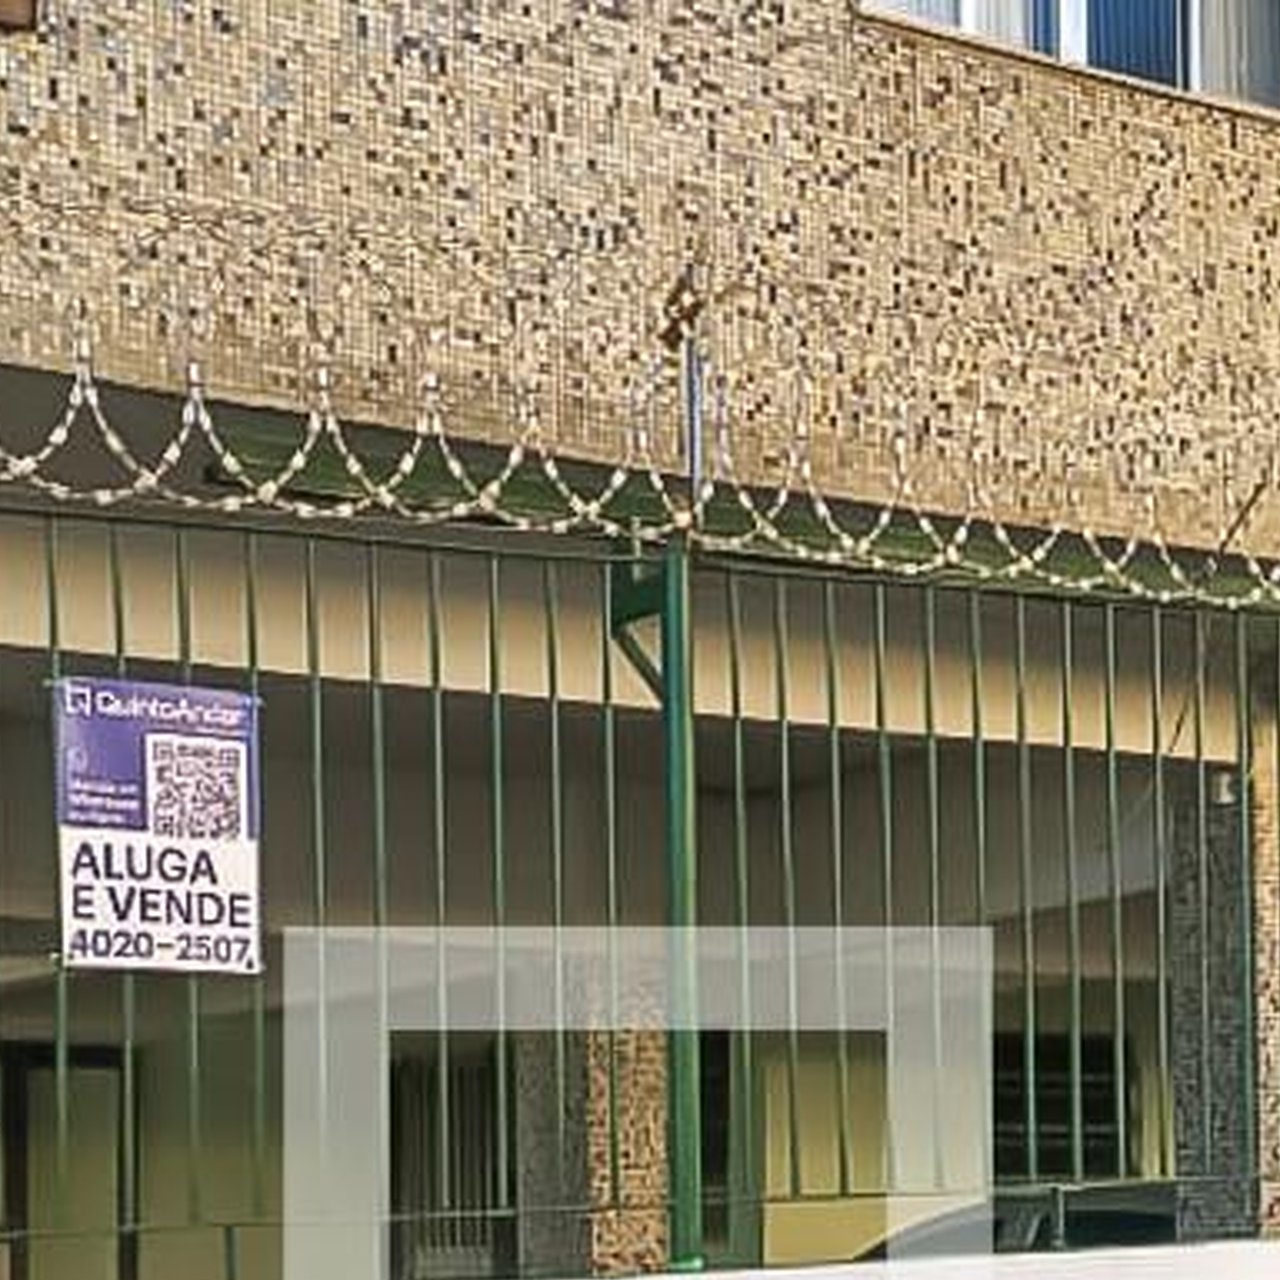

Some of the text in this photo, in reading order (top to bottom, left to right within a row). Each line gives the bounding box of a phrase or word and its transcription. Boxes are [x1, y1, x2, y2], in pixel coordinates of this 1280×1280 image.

[72, 842, 218, 884] ALUGA
[73, 886, 252, 927] E VENDE
[71, 929, 251, 963] 4020-2507
